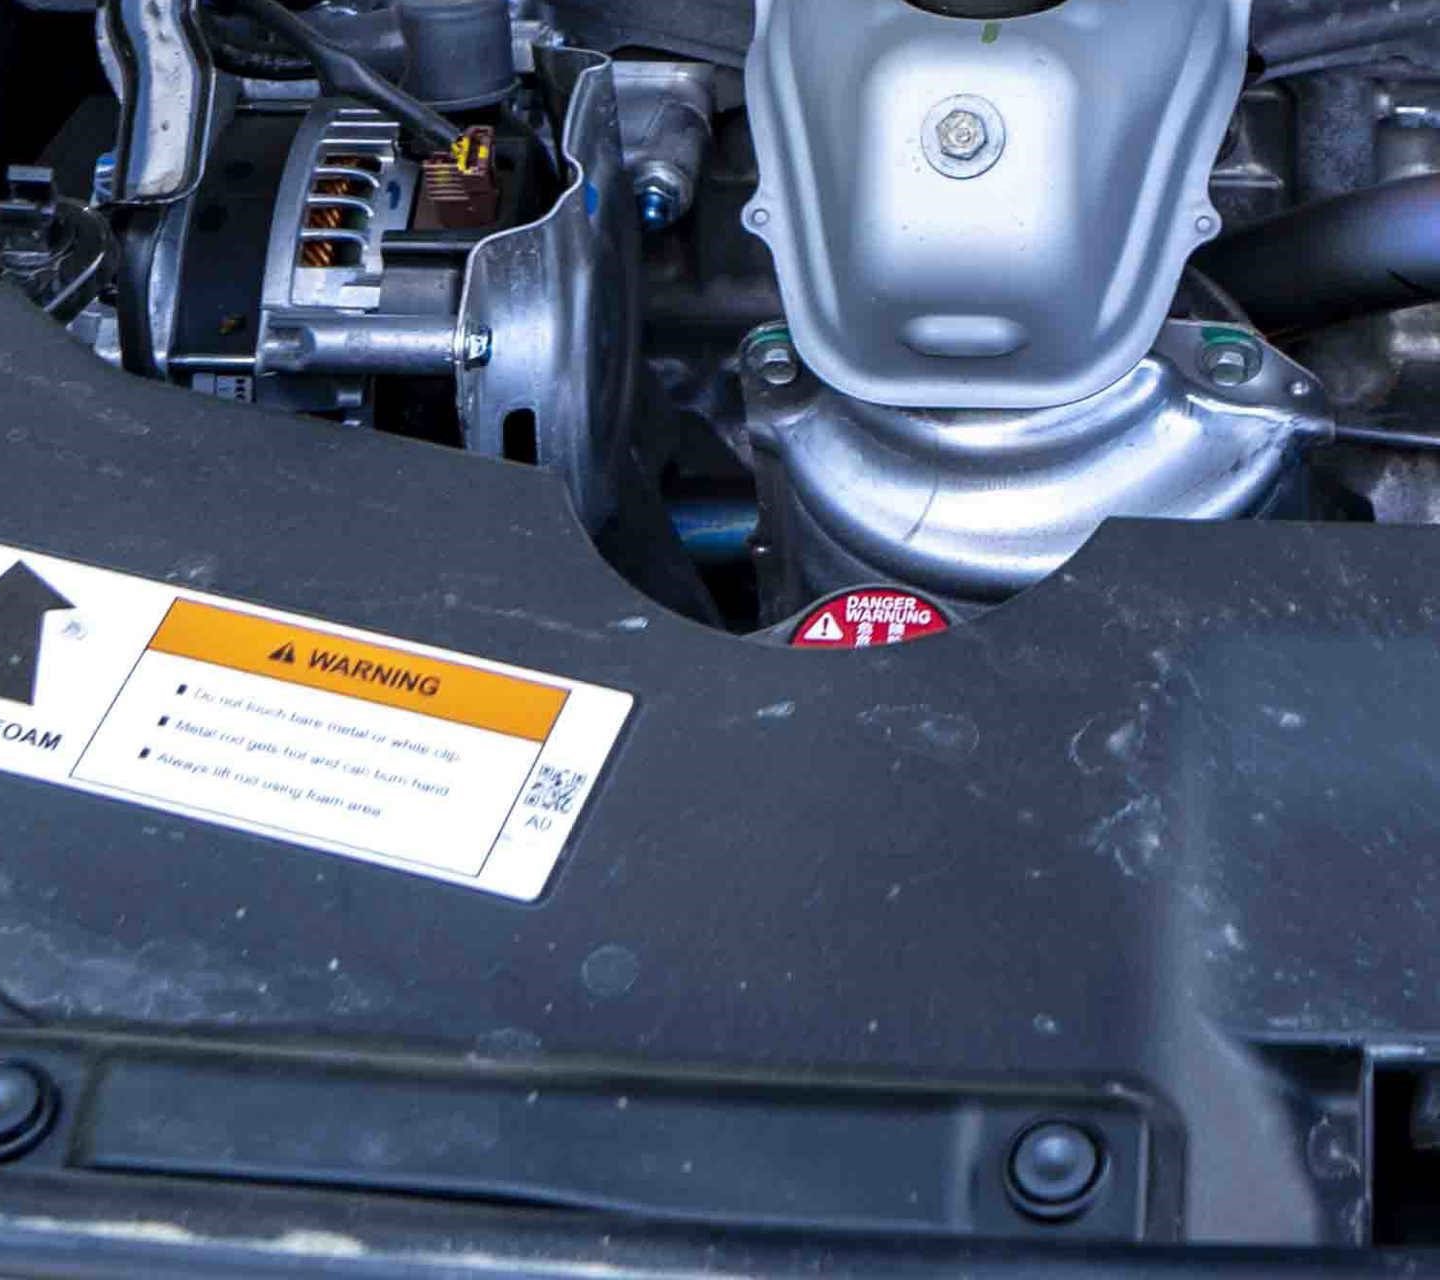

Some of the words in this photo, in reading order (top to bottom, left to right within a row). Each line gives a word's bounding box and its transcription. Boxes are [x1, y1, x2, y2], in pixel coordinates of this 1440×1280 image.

[845, 609, 931, 624] WARNUNG
[846, 595, 917, 609] DANGER
[307, 647, 441, 697] WARNING
[219, 694, 242, 709] not
[290, 708, 322, 728] bare
[328, 719, 370, 739] metal
[157, 752, 209, 775] Always
[234, 770, 259, 786] rod
[262, 778, 303, 800] using
[306, 788, 344, 808] foam
[175, 718, 216, 738] Metal
[220, 730, 244, 744] rod
[247, 738, 277, 757] gets
[283, 743, 307, 760] hot
[310, 754, 339, 769] and
[412, 777, 450, 797] hand
